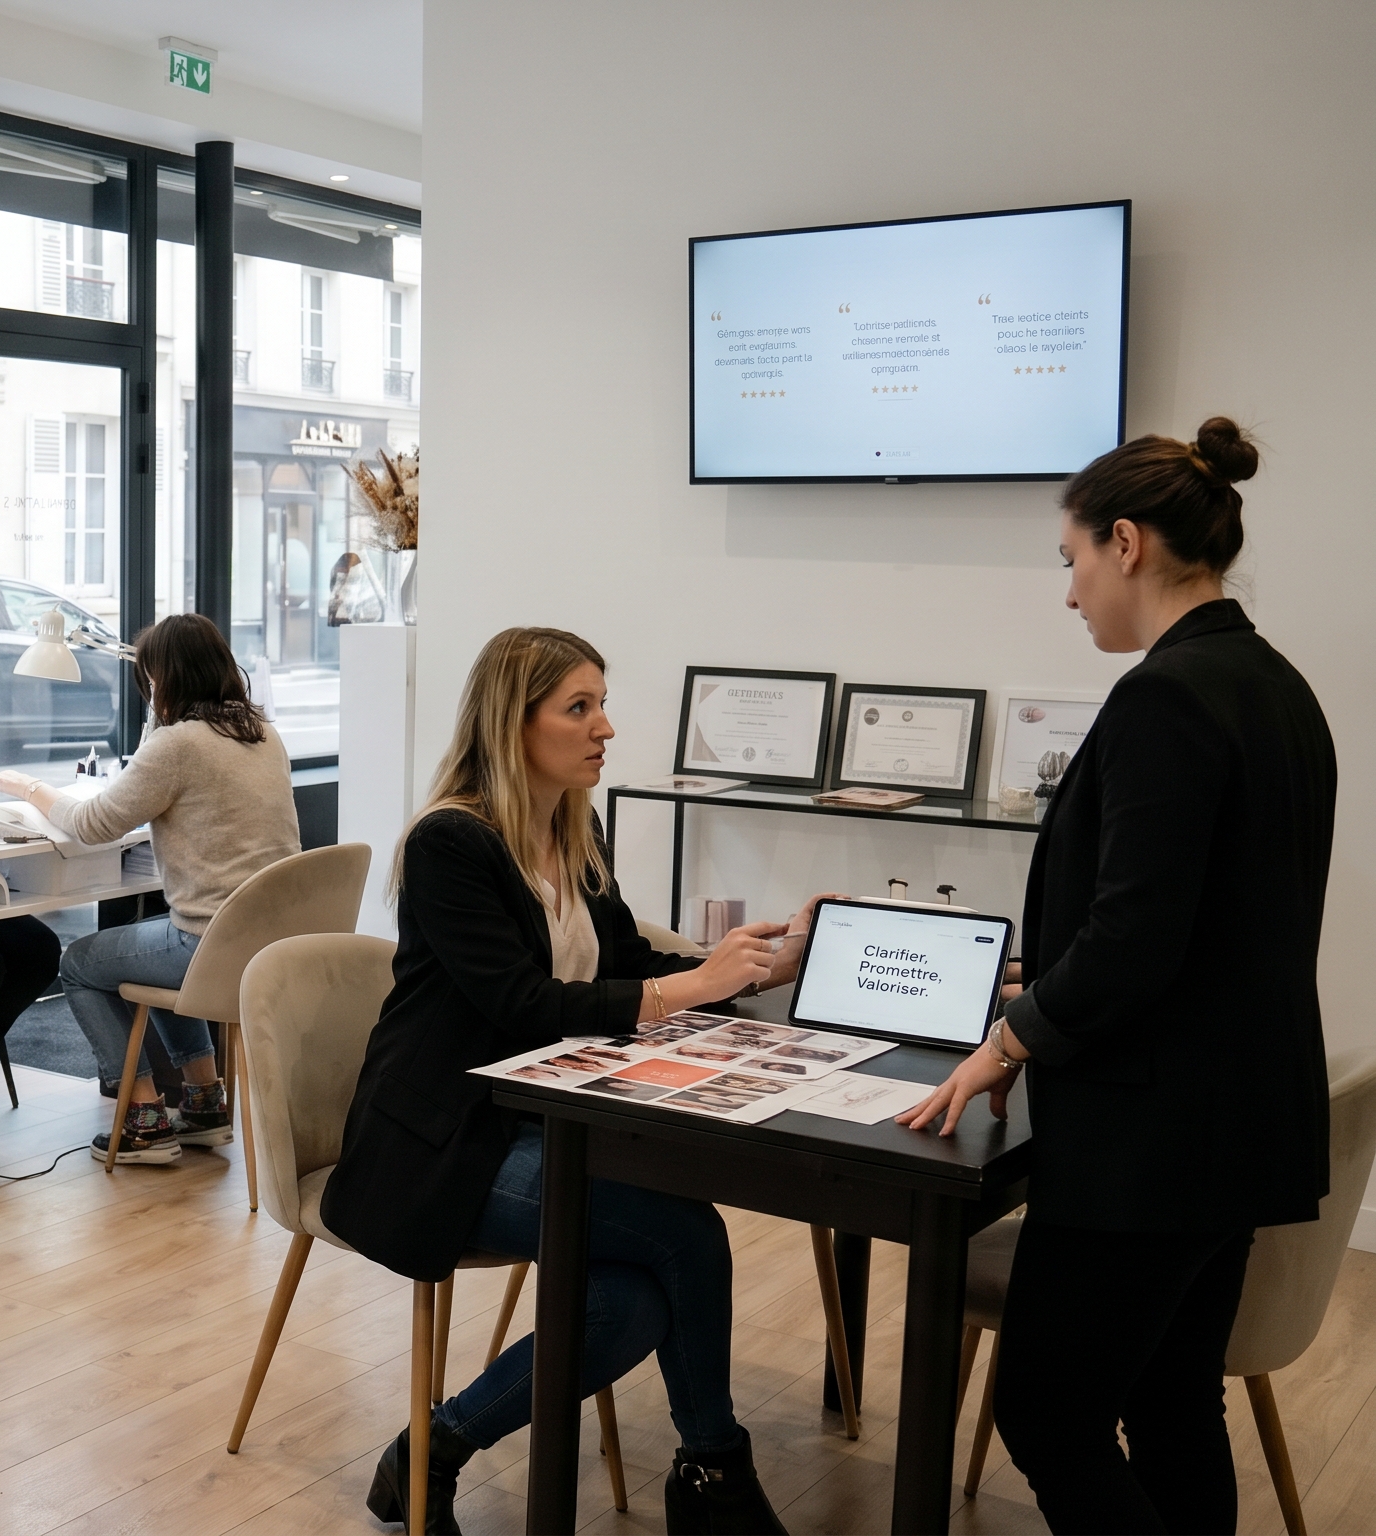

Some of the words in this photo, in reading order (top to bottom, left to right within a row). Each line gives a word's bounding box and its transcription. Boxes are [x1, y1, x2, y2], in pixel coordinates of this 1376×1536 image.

[863, 944, 928, 965] Clarifier,
[858, 960, 942, 984] Promettre,
[857, 976, 928, 997] Valoriser.
